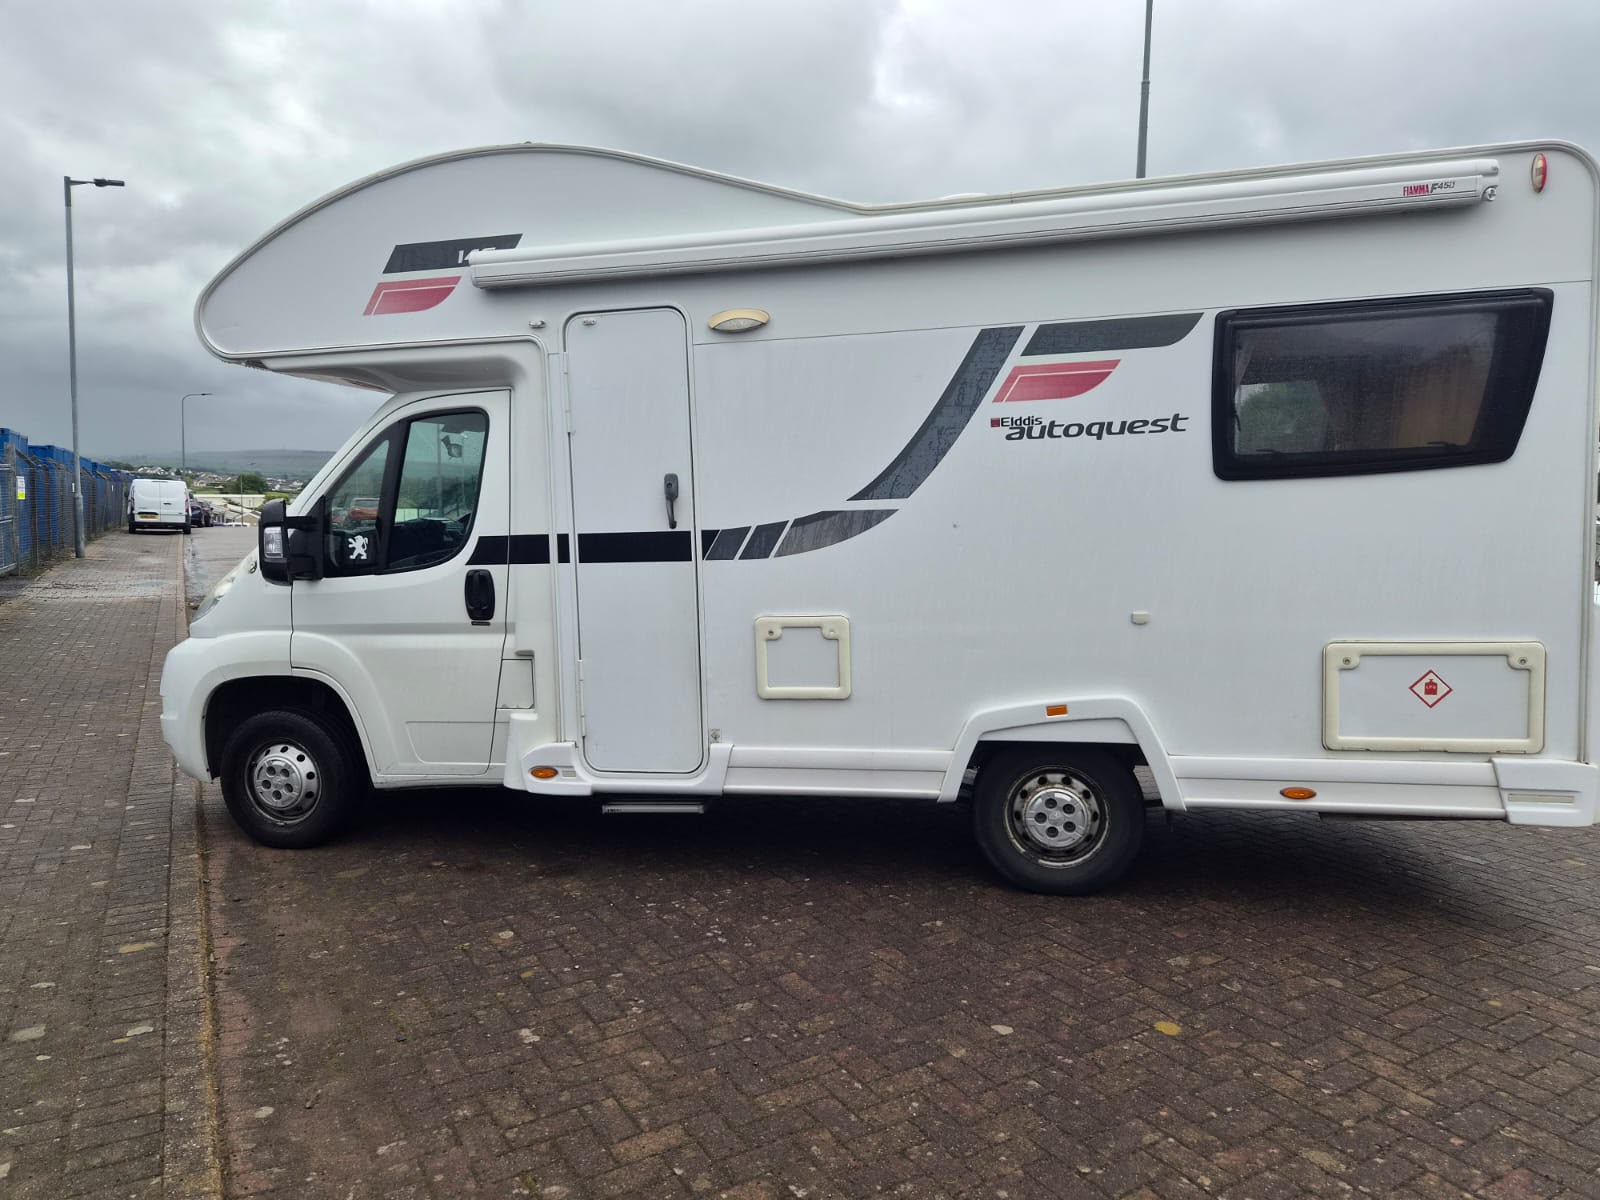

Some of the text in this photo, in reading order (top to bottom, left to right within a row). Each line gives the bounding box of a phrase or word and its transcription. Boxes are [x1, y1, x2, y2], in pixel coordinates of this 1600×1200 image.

[1403, 184, 1429, 196] FIAMMA
[1000, 415, 1043, 428] Elddis
[1005, 413, 1189, 440] autoquest
